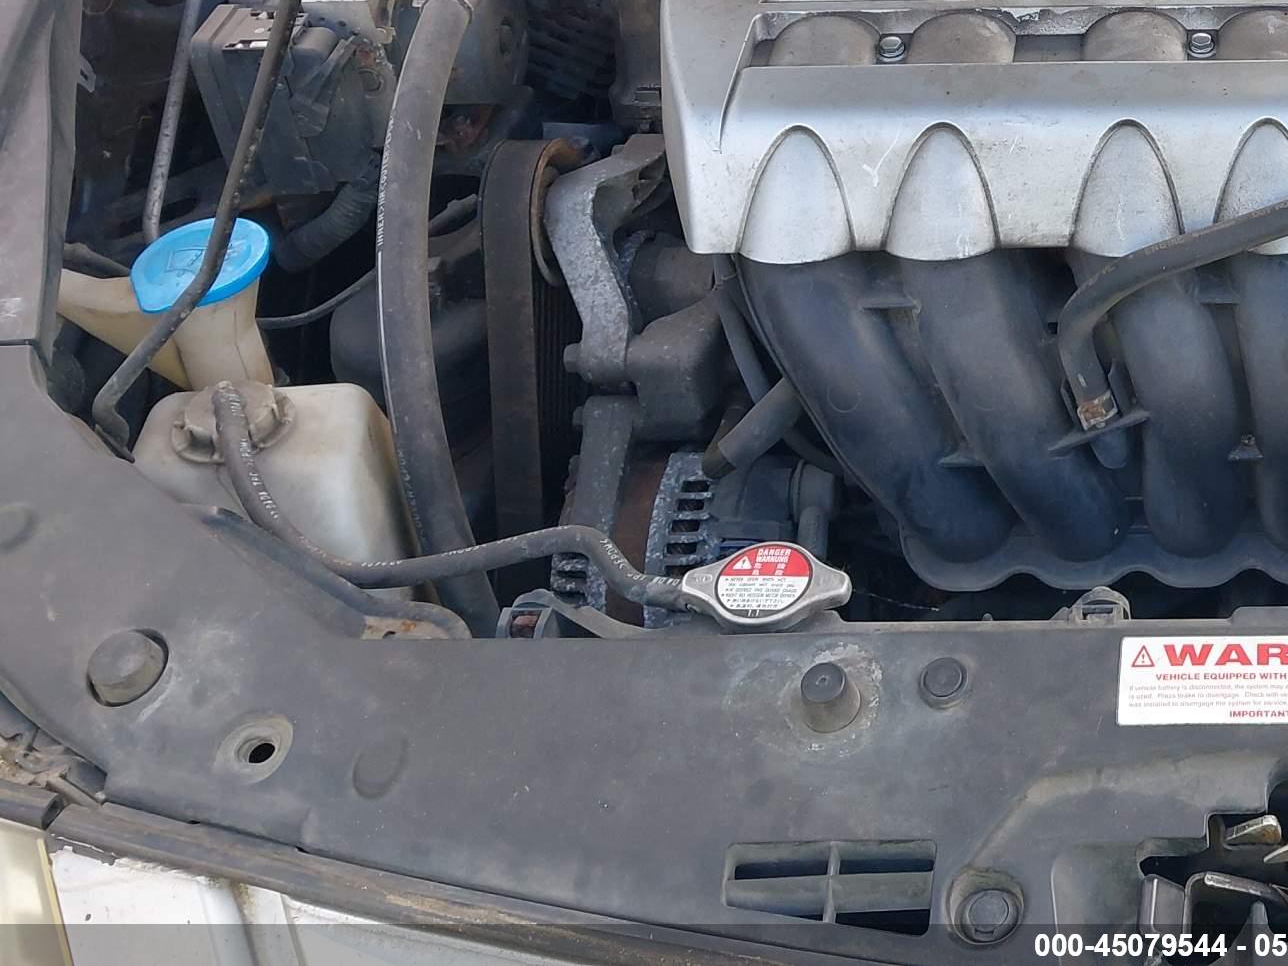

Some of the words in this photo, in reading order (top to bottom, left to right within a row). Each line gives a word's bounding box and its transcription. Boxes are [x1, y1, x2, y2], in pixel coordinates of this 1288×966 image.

[757, 547, 792, 556] DANGER
[1155, 673, 1200, 681] VEHICLE
[1203, 672, 1257, 681] EQUIPPED
[1260, 672, 1287, 680] WITH
